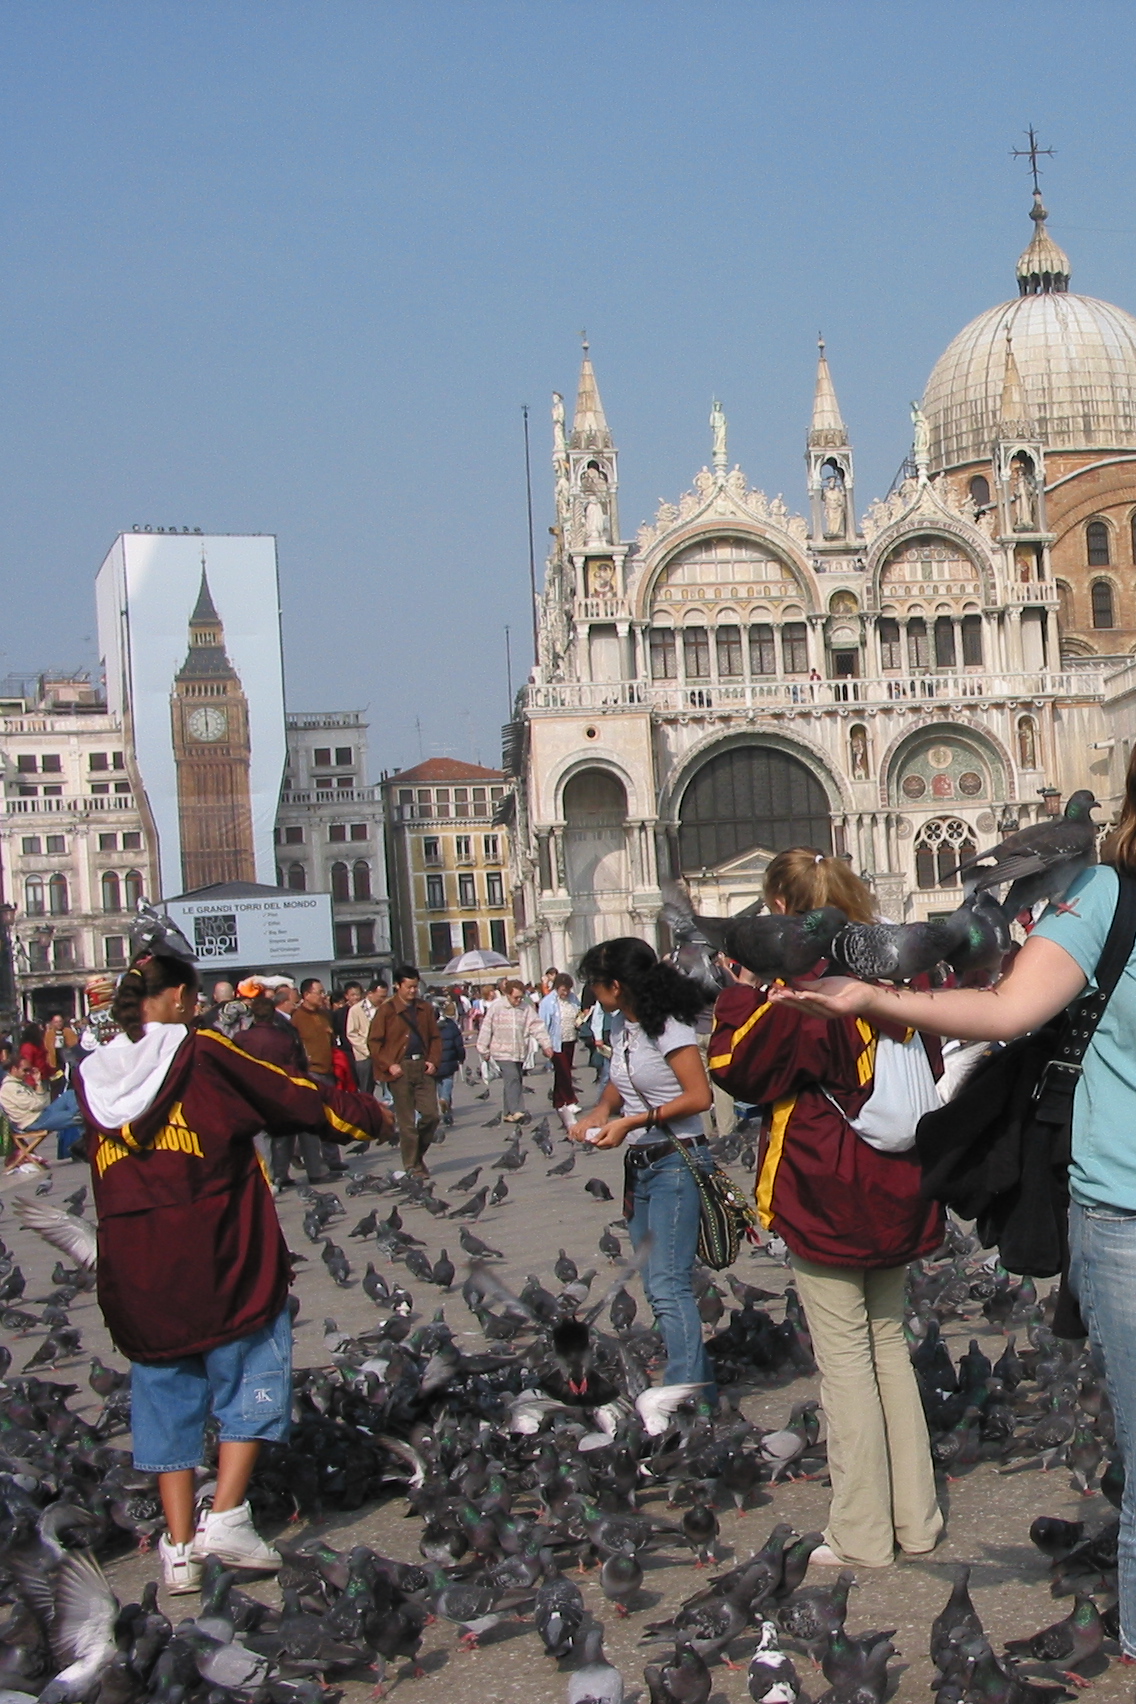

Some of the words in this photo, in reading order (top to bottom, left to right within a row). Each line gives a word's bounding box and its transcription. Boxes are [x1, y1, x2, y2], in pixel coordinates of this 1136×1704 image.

[182, 907, 195, 915] LE
[196, 904, 232, 914] GRANDI
[234, 903, 261, 912] TORRI
[264, 902, 281, 910] DEL
[283, 900, 317, 909] MONDO
[253, 1388, 273, 1404] K
